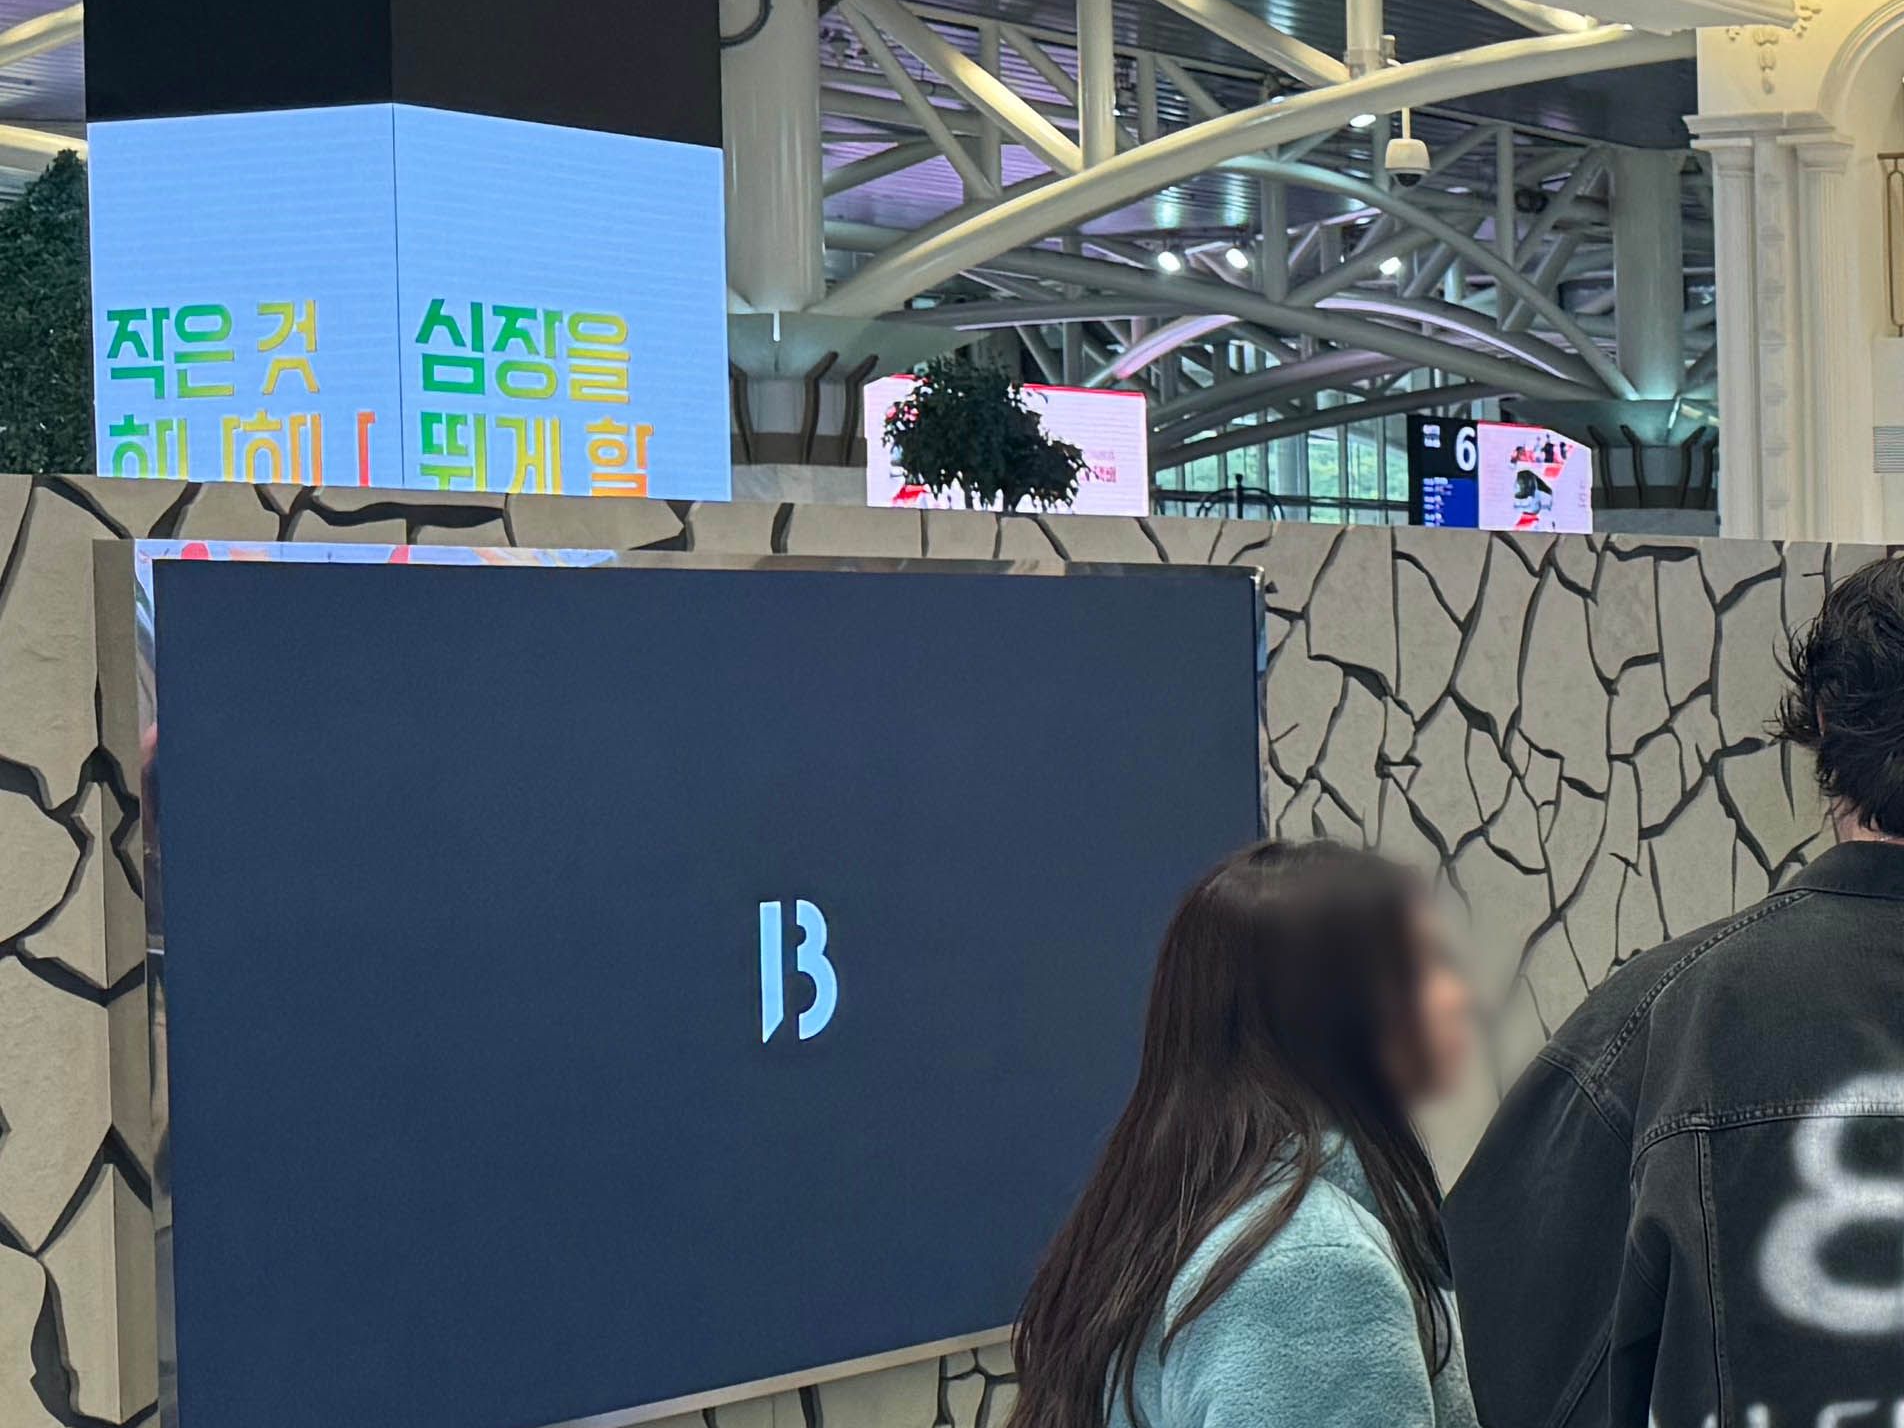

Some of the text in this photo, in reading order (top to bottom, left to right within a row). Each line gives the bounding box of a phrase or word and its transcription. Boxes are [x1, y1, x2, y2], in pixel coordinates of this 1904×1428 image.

[107, 299, 320, 400] 작은 것
[415, 298, 631, 404] 심장을
[1455, 426, 1478, 472] 6
[759, 899, 838, 1044] B
